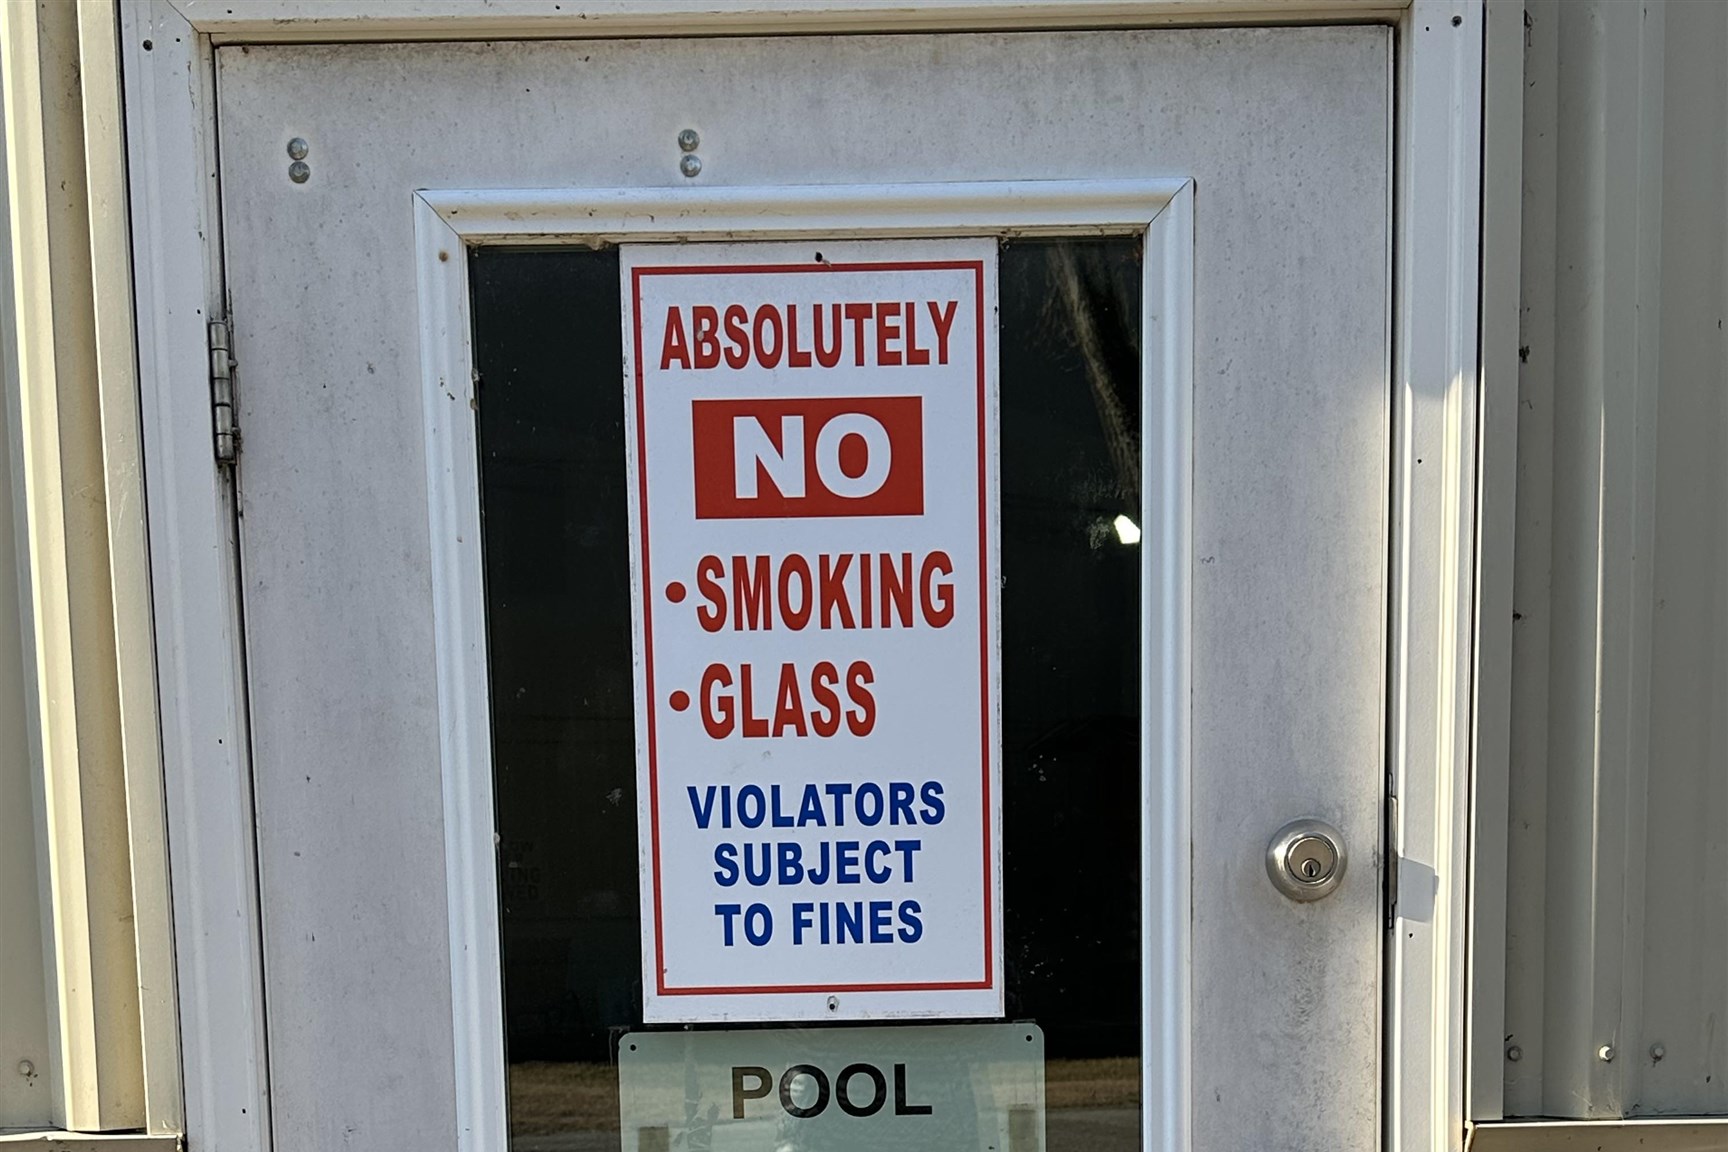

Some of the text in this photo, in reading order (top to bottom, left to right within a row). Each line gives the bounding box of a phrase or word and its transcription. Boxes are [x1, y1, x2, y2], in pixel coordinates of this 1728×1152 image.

[660, 301, 956, 368] ABSOLUTELY
[734, 414, 891, 498] NO
[697, 551, 954, 632] SMOKING
[700, 661, 876, 739] GLASS
[687, 781, 945, 829] VIOLATORS
[714, 840, 921, 886] SUBJECT
[715, 900, 922, 946] TO FINES
[732, 1063, 932, 1119] POOL
